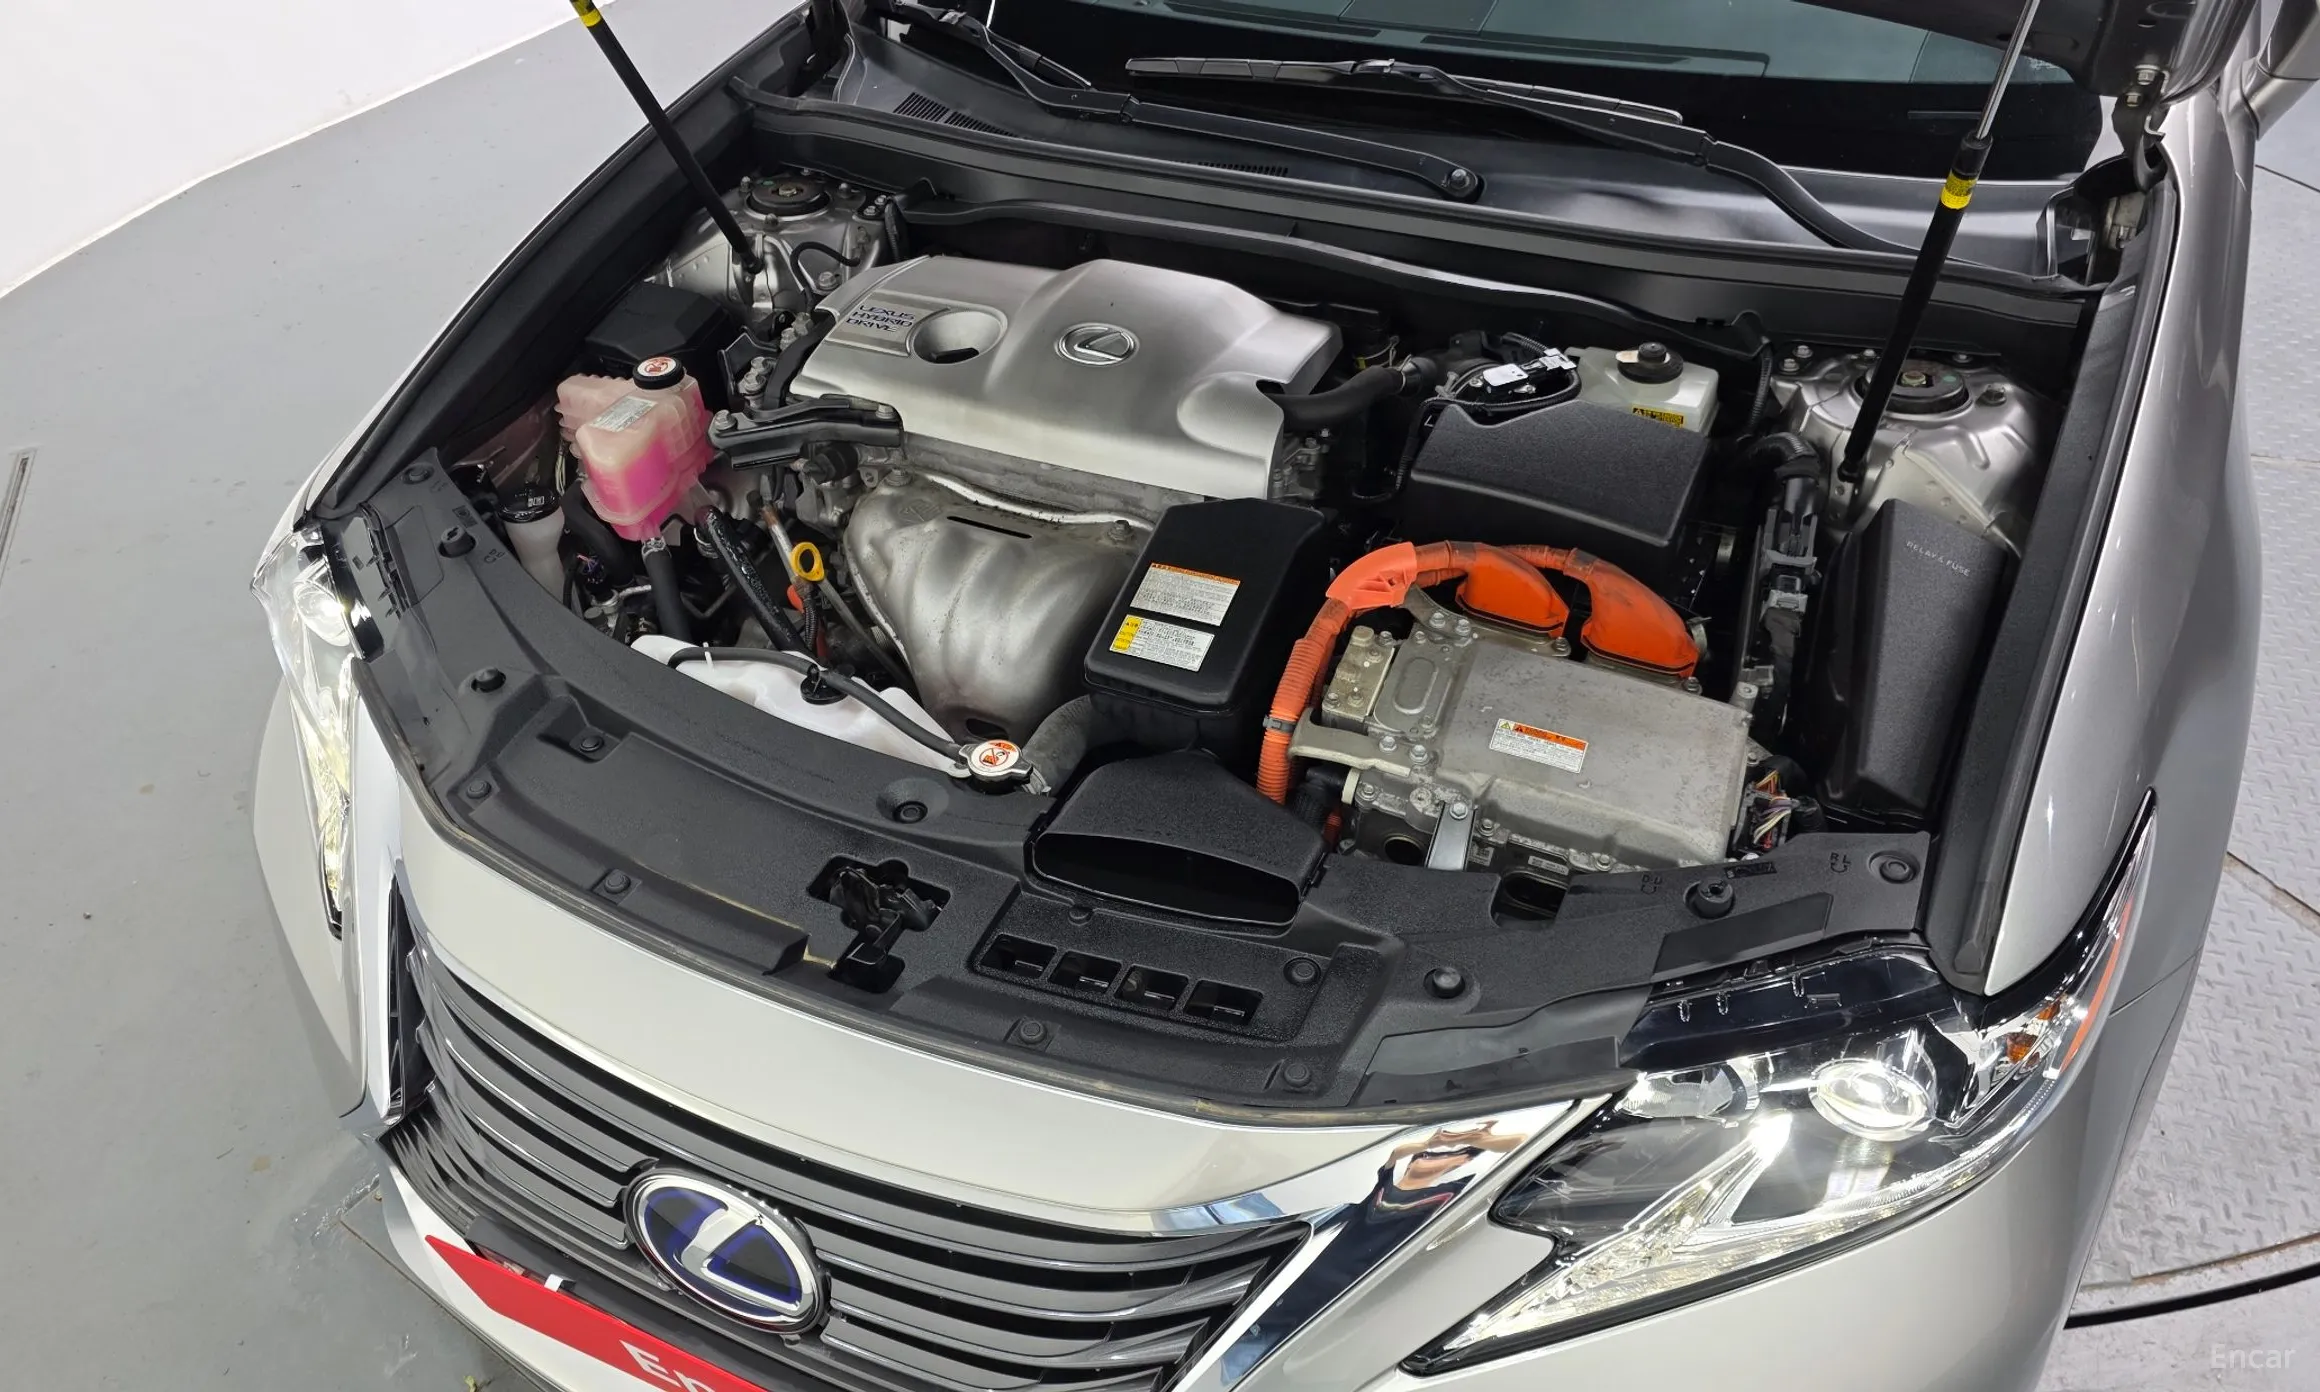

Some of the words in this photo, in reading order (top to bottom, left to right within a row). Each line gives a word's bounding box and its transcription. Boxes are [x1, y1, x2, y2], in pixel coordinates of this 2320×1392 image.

[852, 311, 913, 327] HYBRID
[860, 305, 914, 320] LEXUS
[846, 318, 897, 332] DRIVE
[1906, 540, 1937, 558] RELAY
[1946, 559, 1970, 577] FUSE
